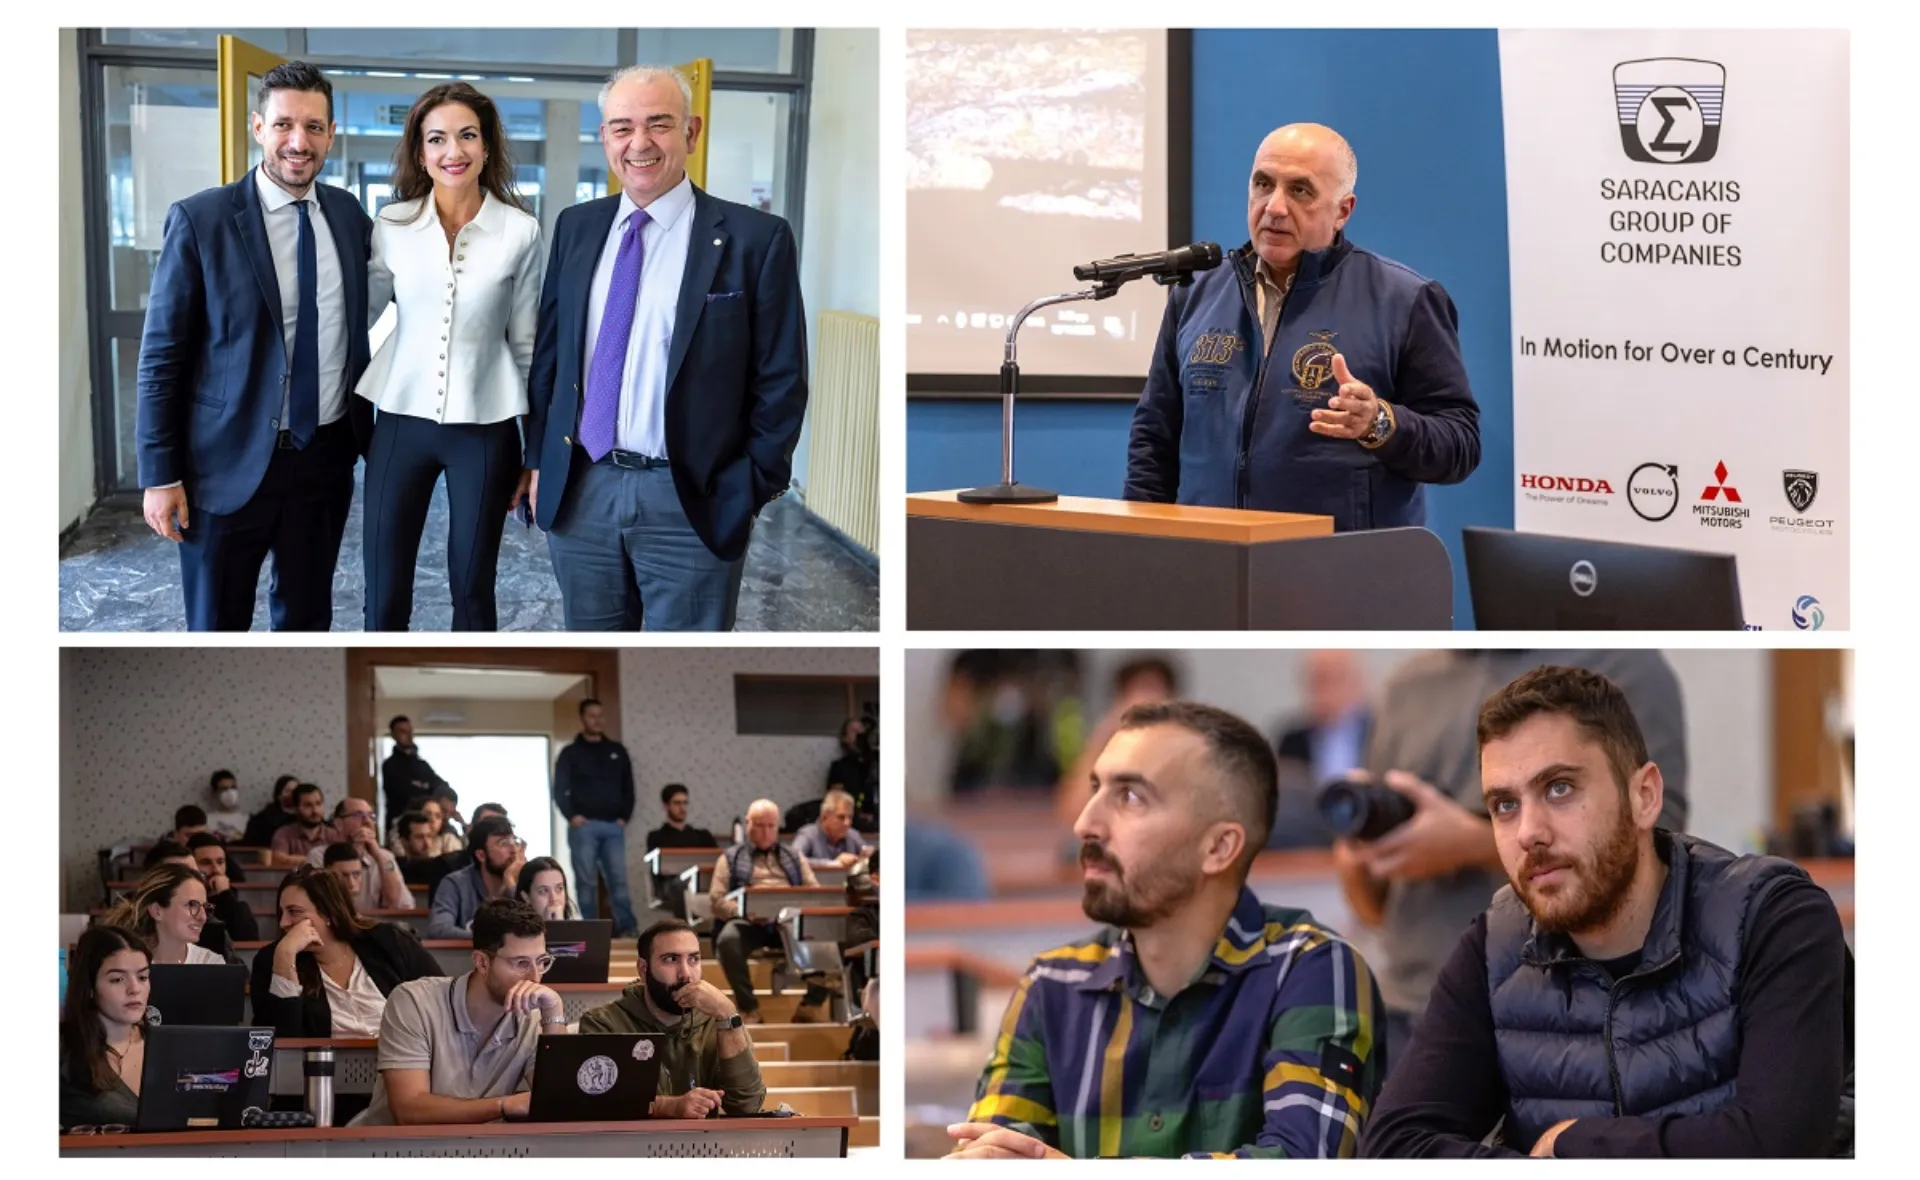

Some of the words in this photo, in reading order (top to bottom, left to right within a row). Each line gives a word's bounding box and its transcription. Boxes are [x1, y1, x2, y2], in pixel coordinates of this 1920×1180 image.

[1600, 178, 1741, 203] SARACAKIS
[1610, 210, 1695, 233] GROUP
[1702, 212, 1733, 234] OF
[1600, 241, 1742, 267] COMPANIES
[1520, 335, 1537, 356] In
[1543, 337, 1618, 360] Motion
[1624, 339, 1654, 362] for
[1660, 341, 1716, 364] Over
[1722, 349, 1736, 366] a
[1743, 345, 1834, 376] Century
[1520, 473, 1615, 495] HONDA
[1633, 487, 1674, 497] VOLVO
[1692, 504, 1751, 519] MITSUBISHI
[1769, 515, 1835, 528] PEUGEOT
[1700, 516, 1743, 530] MOTORS
